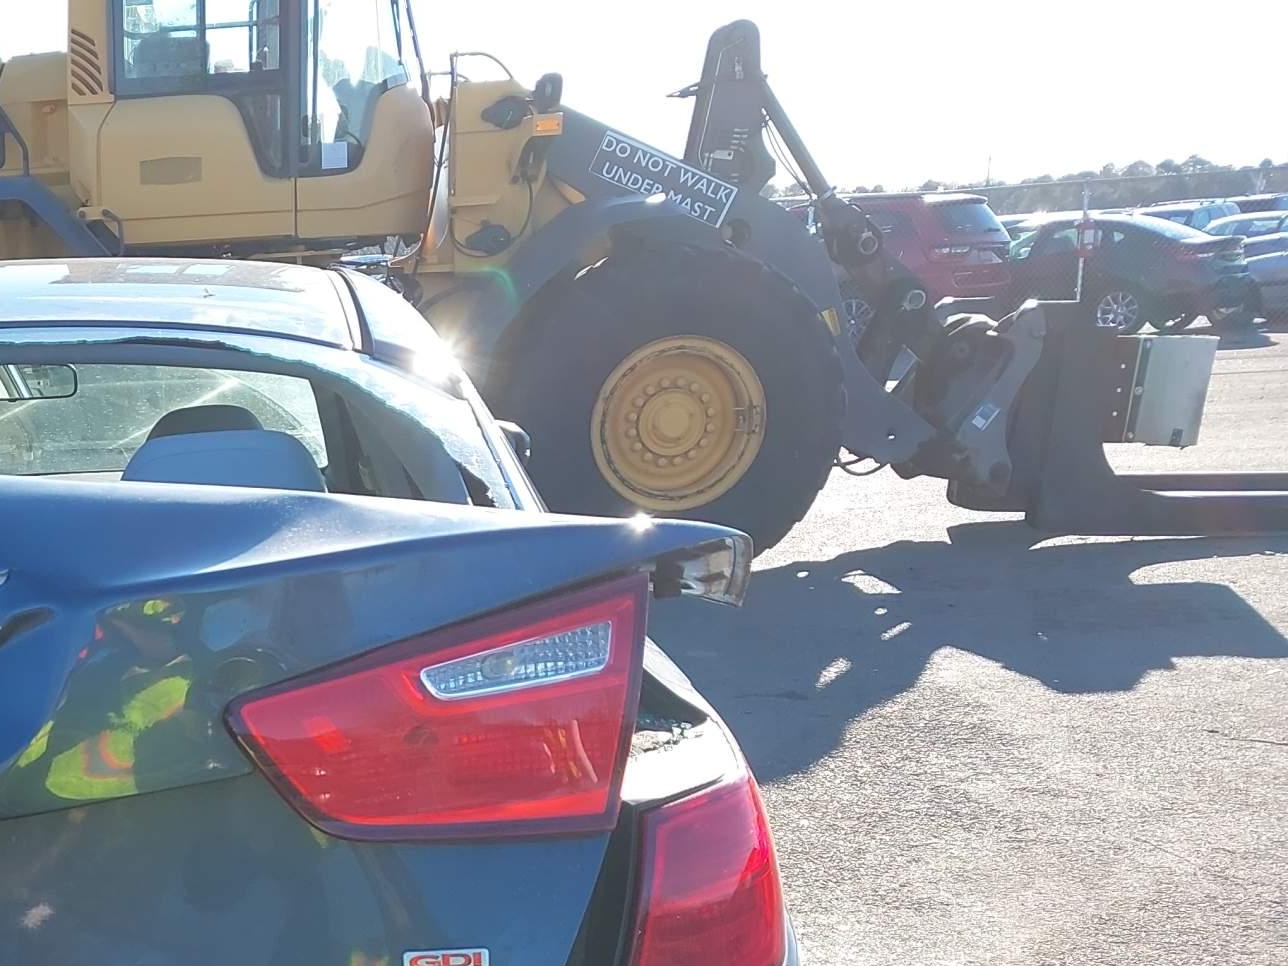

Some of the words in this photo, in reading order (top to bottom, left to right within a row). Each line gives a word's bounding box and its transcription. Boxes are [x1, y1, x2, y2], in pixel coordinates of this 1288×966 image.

[602, 136, 631, 158] DO
[633, 150, 678, 178] NOT
[680, 168, 732, 204] WALK
[602, 161, 663, 196] UNDER
[667, 189, 716, 221] MAST
